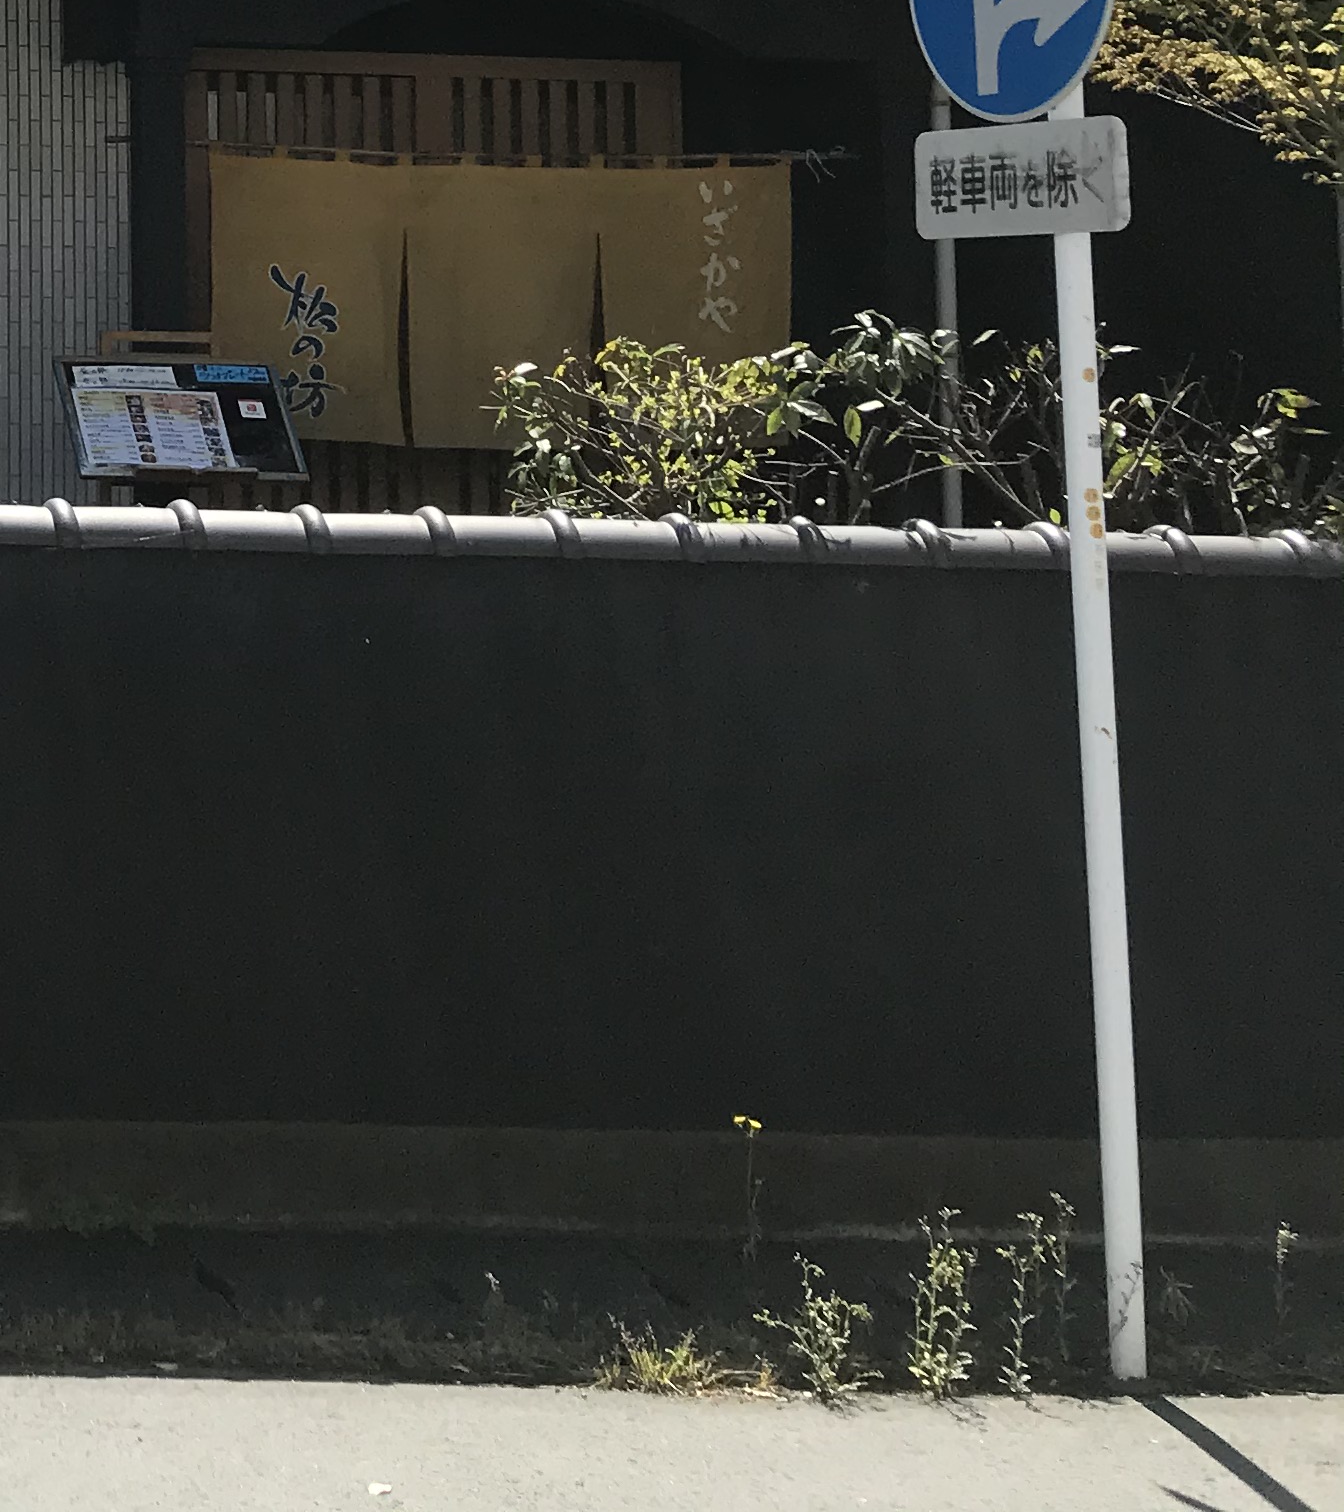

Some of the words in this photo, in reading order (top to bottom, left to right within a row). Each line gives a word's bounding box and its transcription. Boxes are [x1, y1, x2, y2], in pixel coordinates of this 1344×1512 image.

[698, 180, 741, 333] いざかや
[929, 146, 1105, 215] 軽車両を除く
[268, 263, 345, 419] 松の坊
